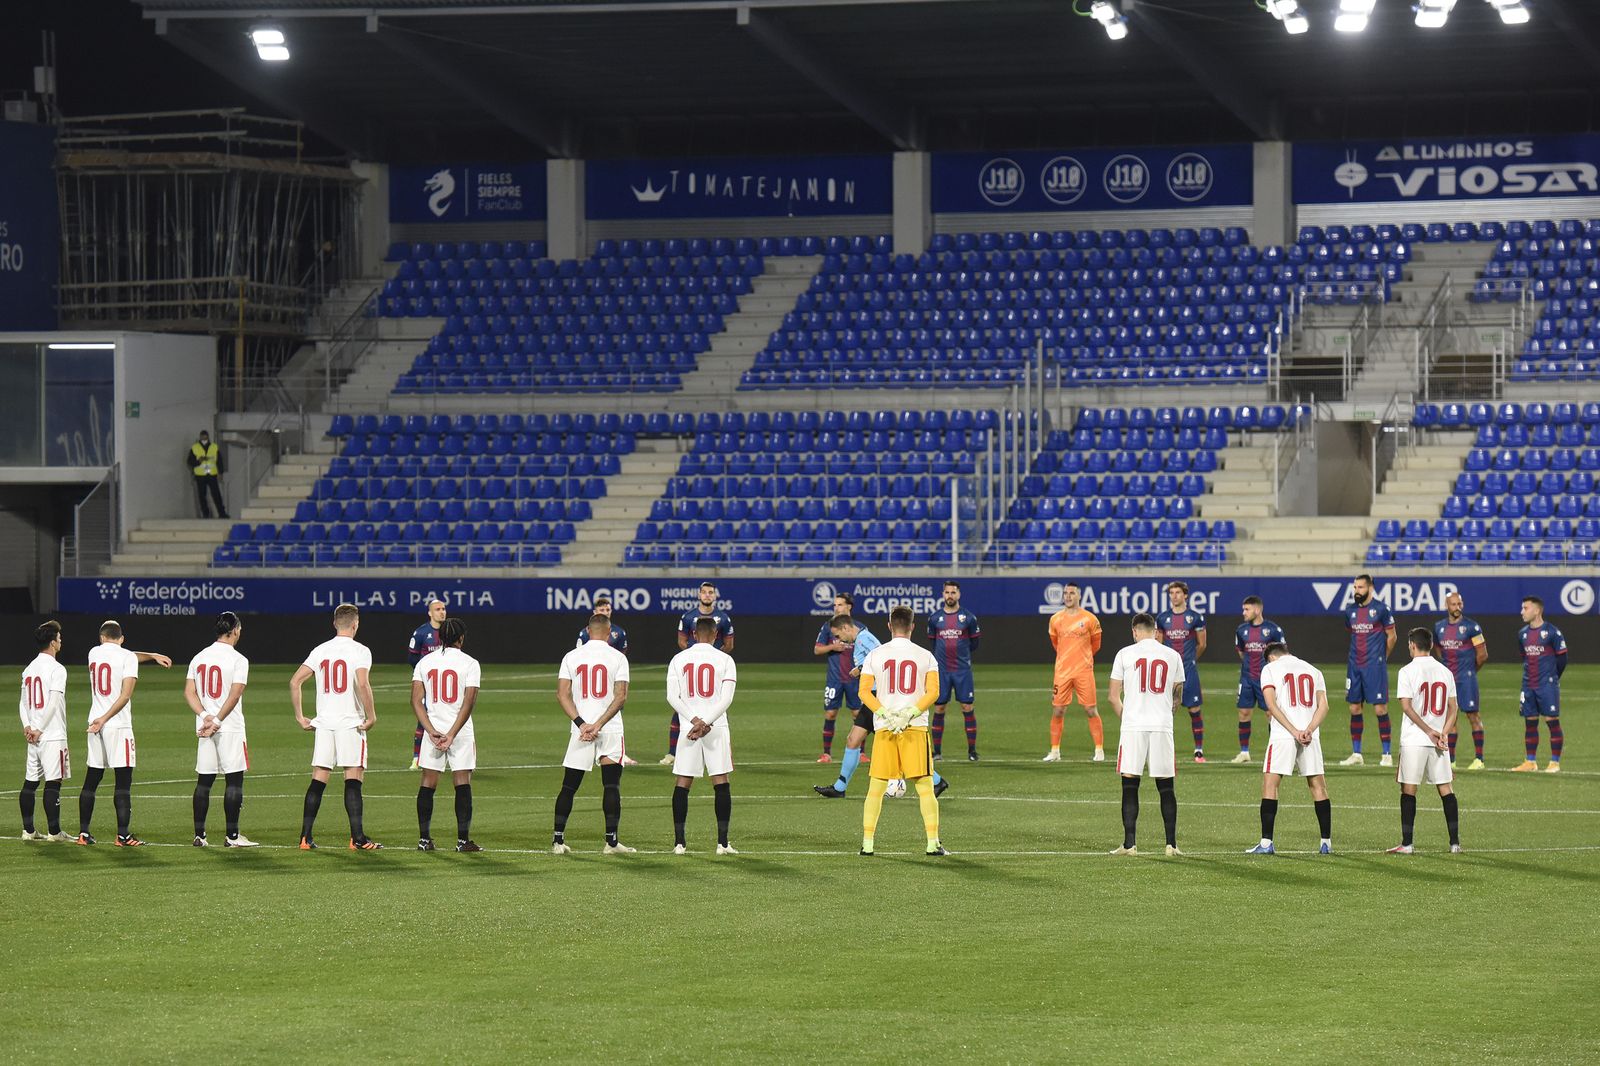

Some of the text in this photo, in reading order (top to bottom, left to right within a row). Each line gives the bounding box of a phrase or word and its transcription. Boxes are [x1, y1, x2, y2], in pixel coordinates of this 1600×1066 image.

[478, 172, 512, 185] FIELES
[985, 167, 1019, 190] J10
[1047, 166, 1081, 188] J10
[1110, 164, 1144, 187] J10
[1173, 162, 1207, 185] J10
[478, 186, 521, 198] SIEMPRE
[128, 581, 244, 603] federópticos
[312, 590, 495, 607] LILLAS PASTIA
[853, 583, 933, 597] Automóviles
[129, 603, 196, 616] Pérez Bolea
[660, 600, 668, 610] Y
[89, 662, 112, 696] 10
[196, 663, 223, 699] 10
[320, 659, 348, 694] 10
[427, 668, 459, 704] 10
[576, 663, 608, 699] 10
[683, 662, 715, 698] 10
[882, 659, 918, 695] 10
[1134, 657, 1169, 694] 10
[25, 676, 44, 710] 10
[825, 686, 836, 699] 20
[1284, 672, 1315, 708] 10
[1419, 681, 1447, 717] 10
